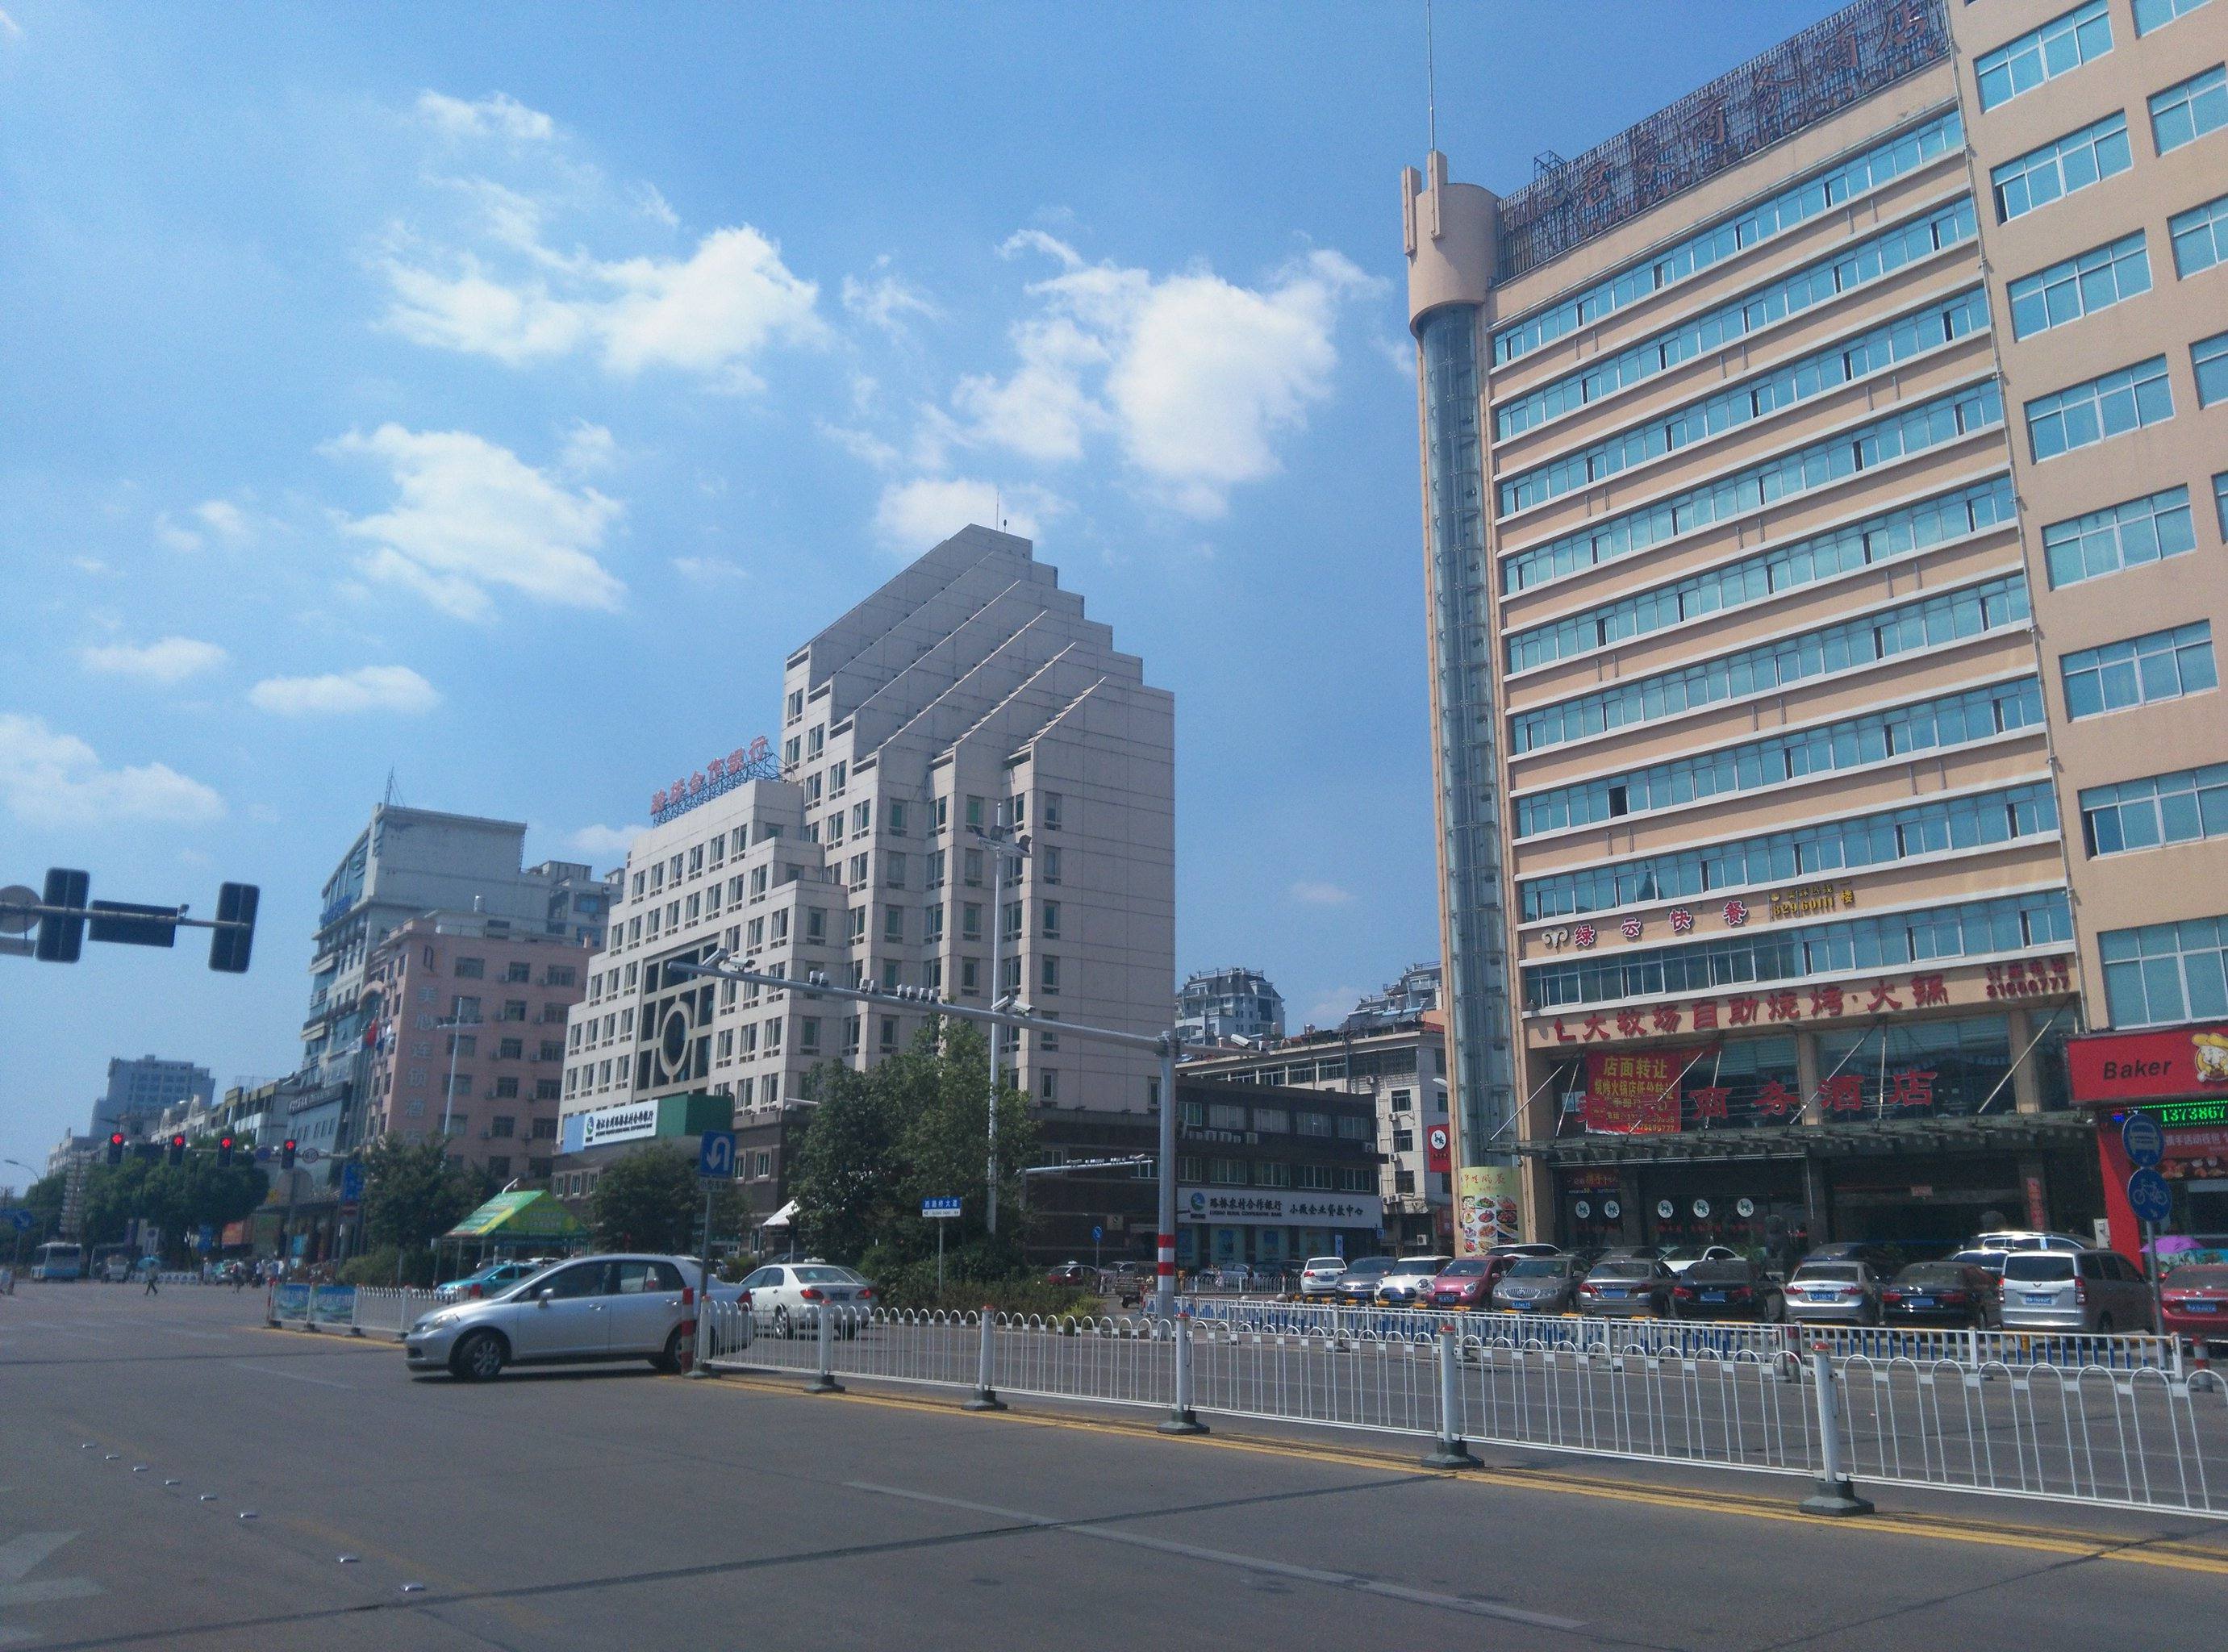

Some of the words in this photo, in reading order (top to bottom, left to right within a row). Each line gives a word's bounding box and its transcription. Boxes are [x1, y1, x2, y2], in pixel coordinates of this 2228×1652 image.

[1574, 900, 1747, 946] 绿云快餐
[1604, 1057, 1667, 1078] 店面转让
[2103, 1059, 2172, 1080] Baker
